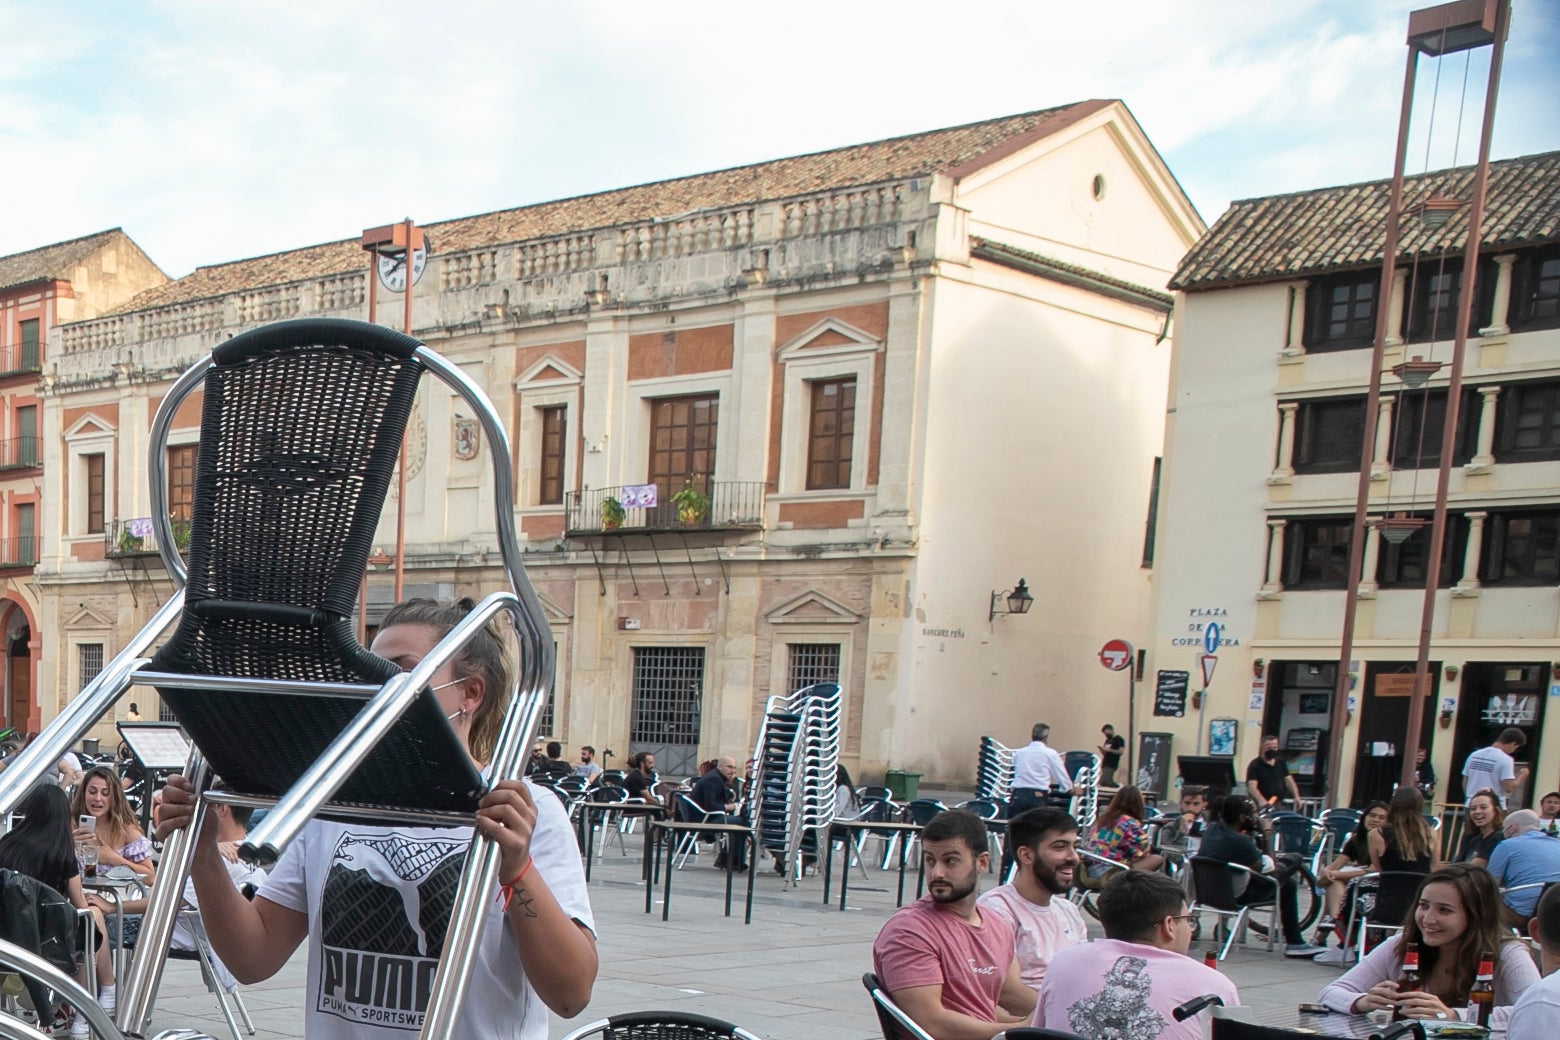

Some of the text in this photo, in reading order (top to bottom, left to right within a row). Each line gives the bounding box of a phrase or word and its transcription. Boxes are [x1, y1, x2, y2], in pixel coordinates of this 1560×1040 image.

[1190, 608, 1227, 616] PLAZA
[1188, 623, 1202, 631] DE
[1171, 638, 1239, 646] CORRERA
[323, 996, 425, 1026] PUMA SPORTSWE
